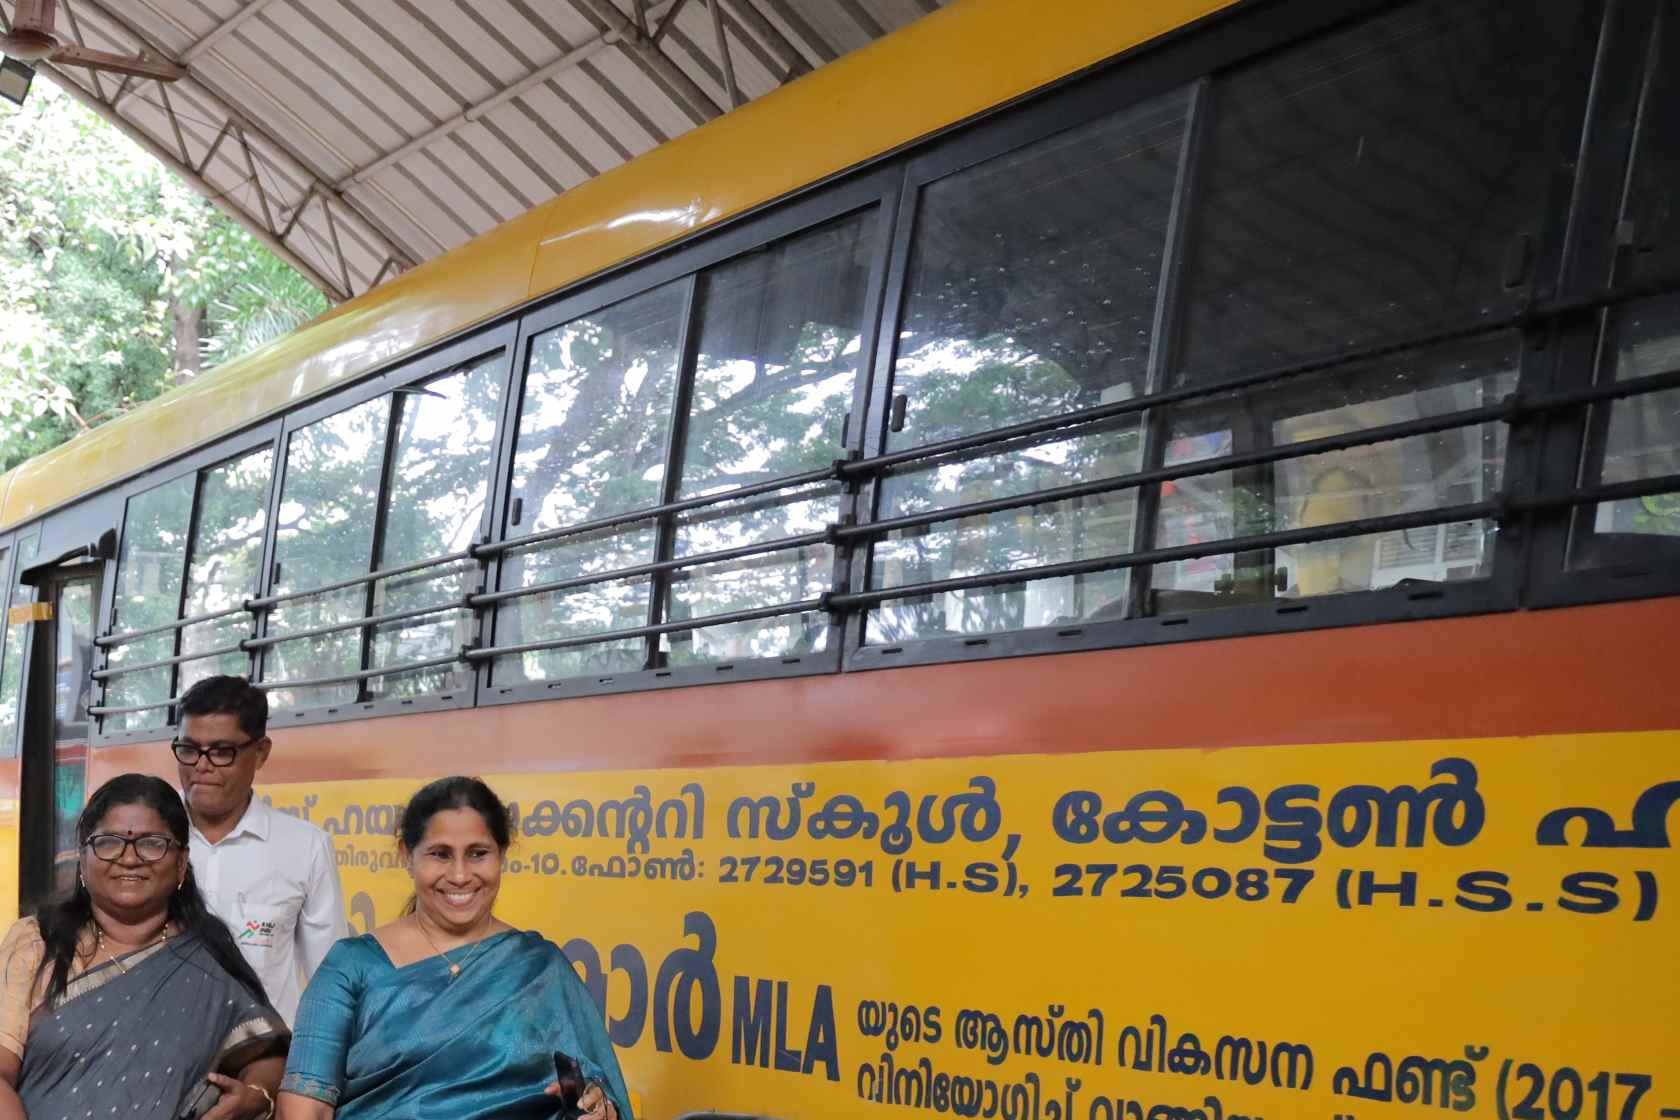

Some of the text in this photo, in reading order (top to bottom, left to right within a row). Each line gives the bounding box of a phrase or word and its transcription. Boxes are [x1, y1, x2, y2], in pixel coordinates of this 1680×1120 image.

[718, 855, 874, 887] 2729591
[1052, 862, 1315, 904] 2725087
[1336, 869, 1659, 921] (H.S.S)
[731, 975, 841, 1082] MLA
